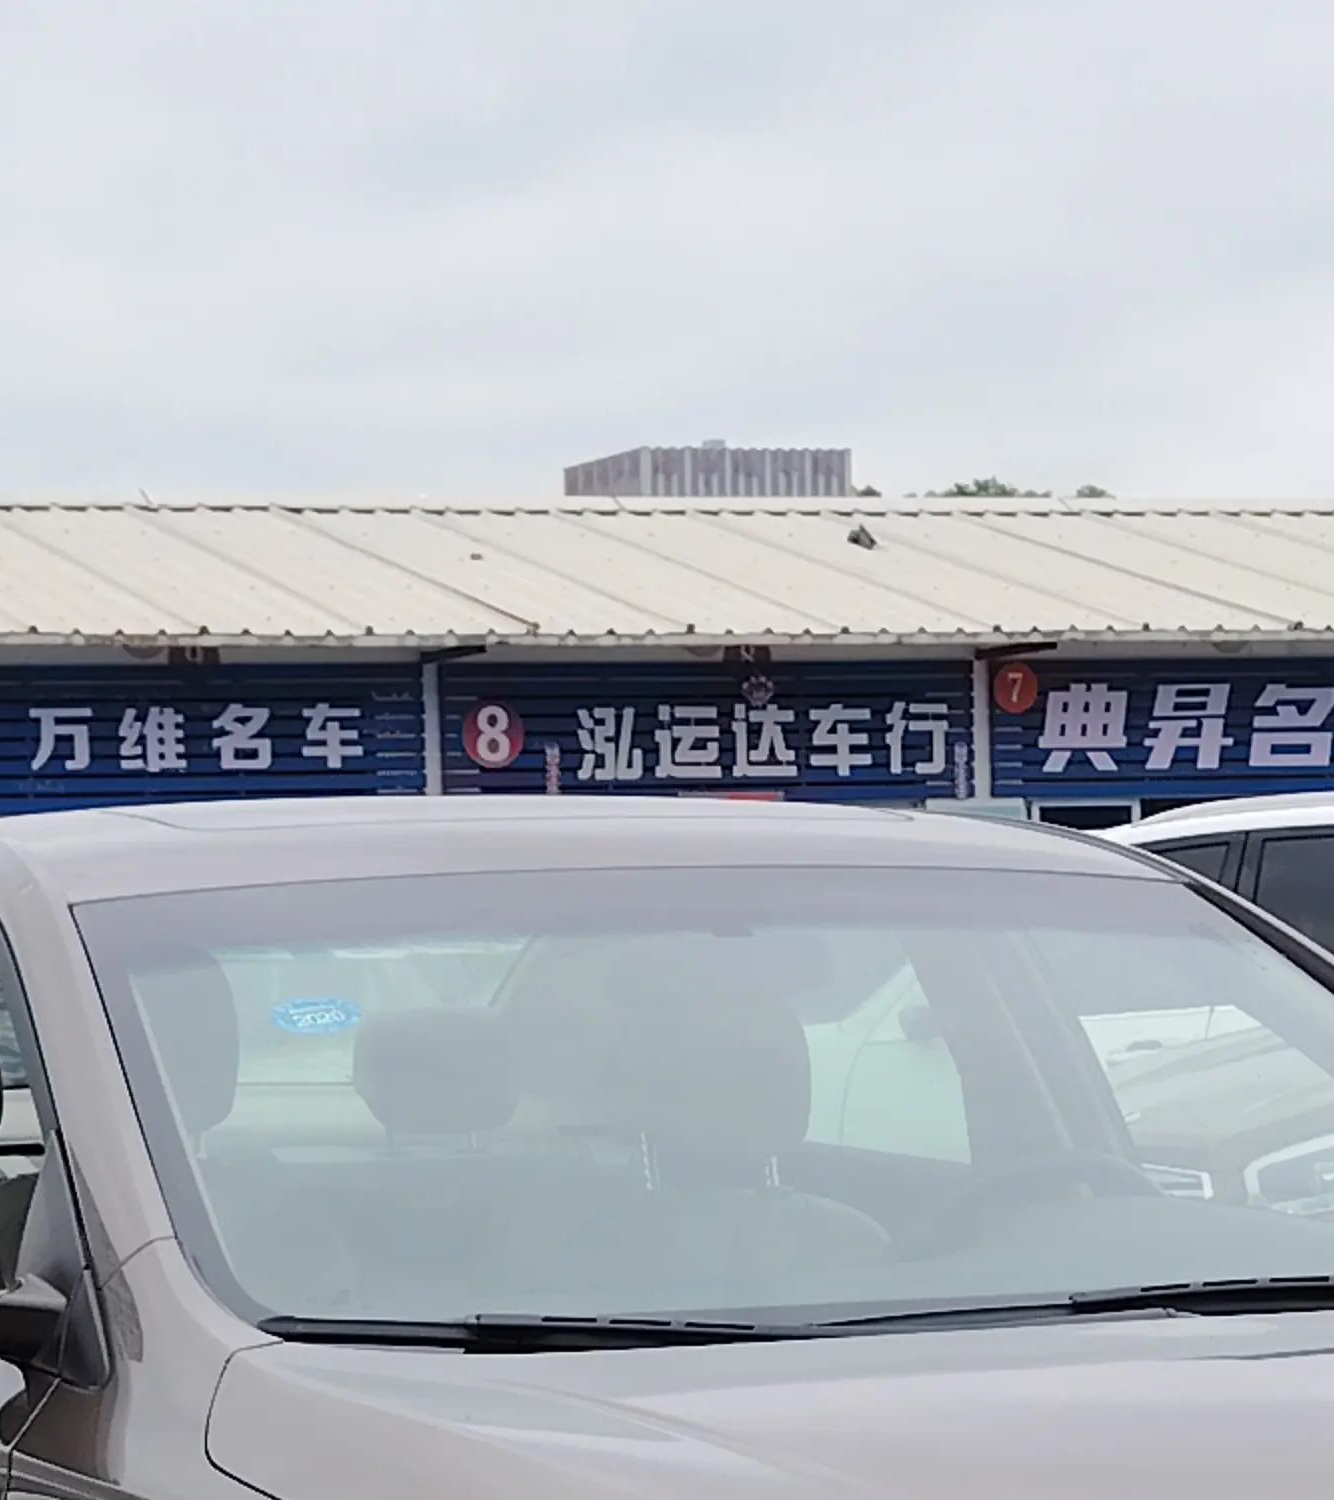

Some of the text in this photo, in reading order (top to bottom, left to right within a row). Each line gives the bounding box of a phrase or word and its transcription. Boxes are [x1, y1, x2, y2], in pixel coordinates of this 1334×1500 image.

[1007, 672, 1025, 703] 7
[28, 703, 364, 773] 万维名车
[476, 705, 511, 764] 8
[576, 701, 949, 781] 泓运达车行
